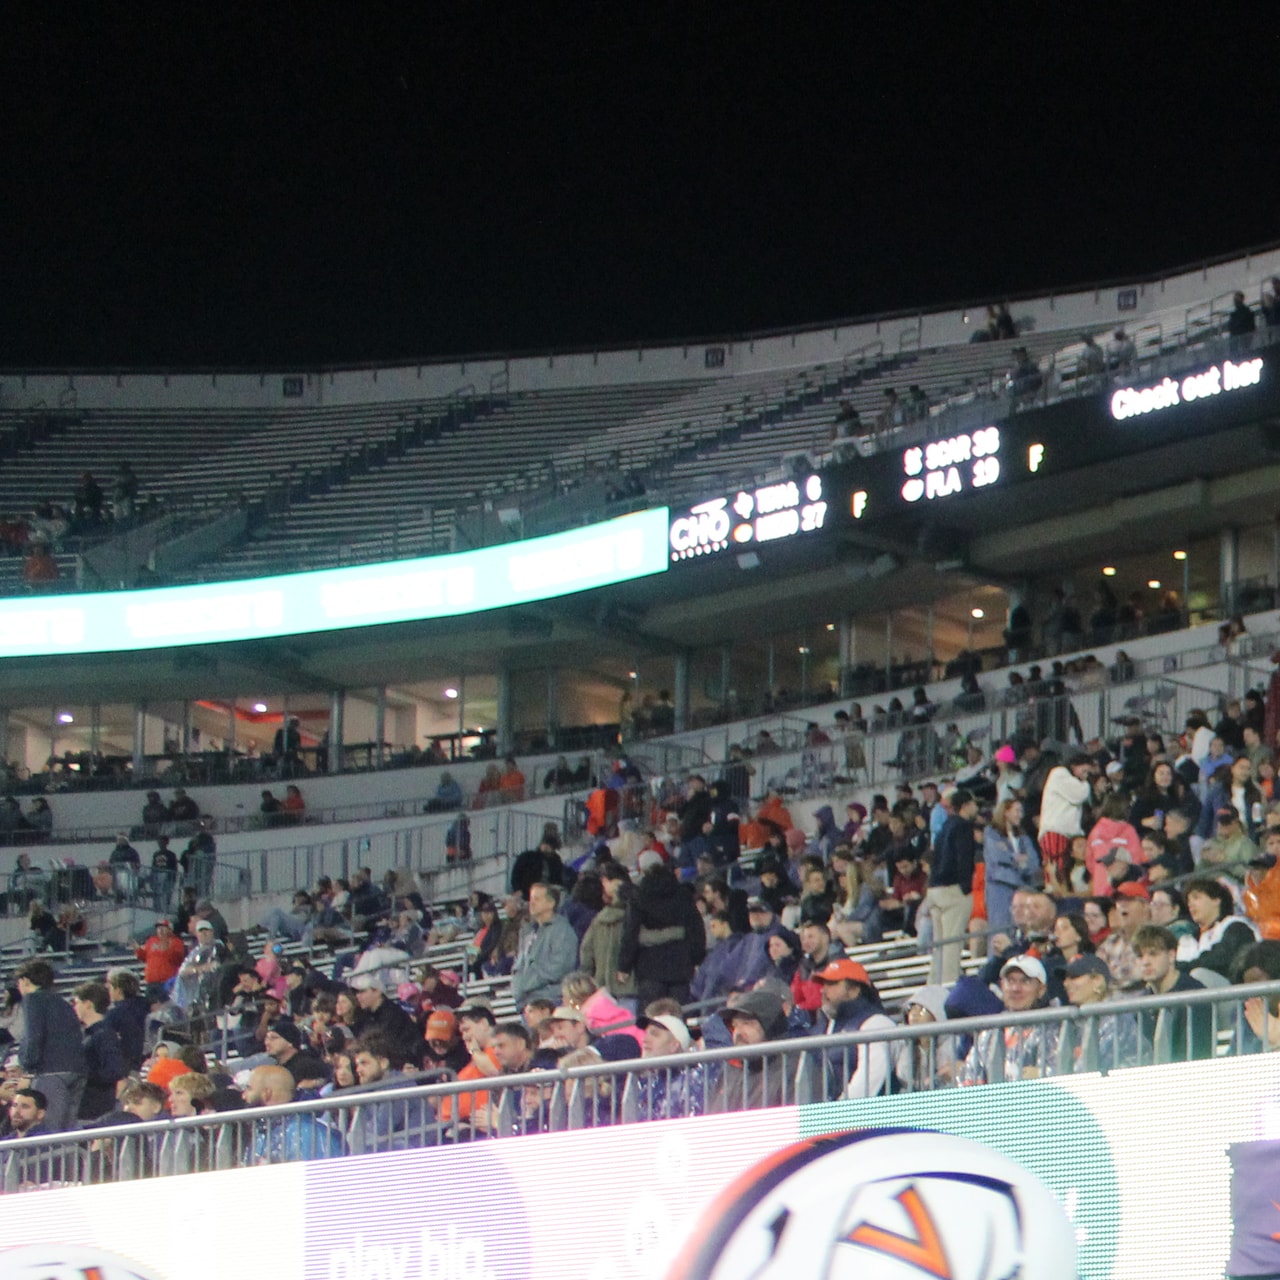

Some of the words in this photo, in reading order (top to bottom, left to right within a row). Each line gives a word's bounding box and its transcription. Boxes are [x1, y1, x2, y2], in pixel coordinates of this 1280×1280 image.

[1111, 377, 1179, 421] Check
[1181, 365, 1221, 402] out
[1027, 443, 1044, 473] F
[852, 490, 868, 519] F
